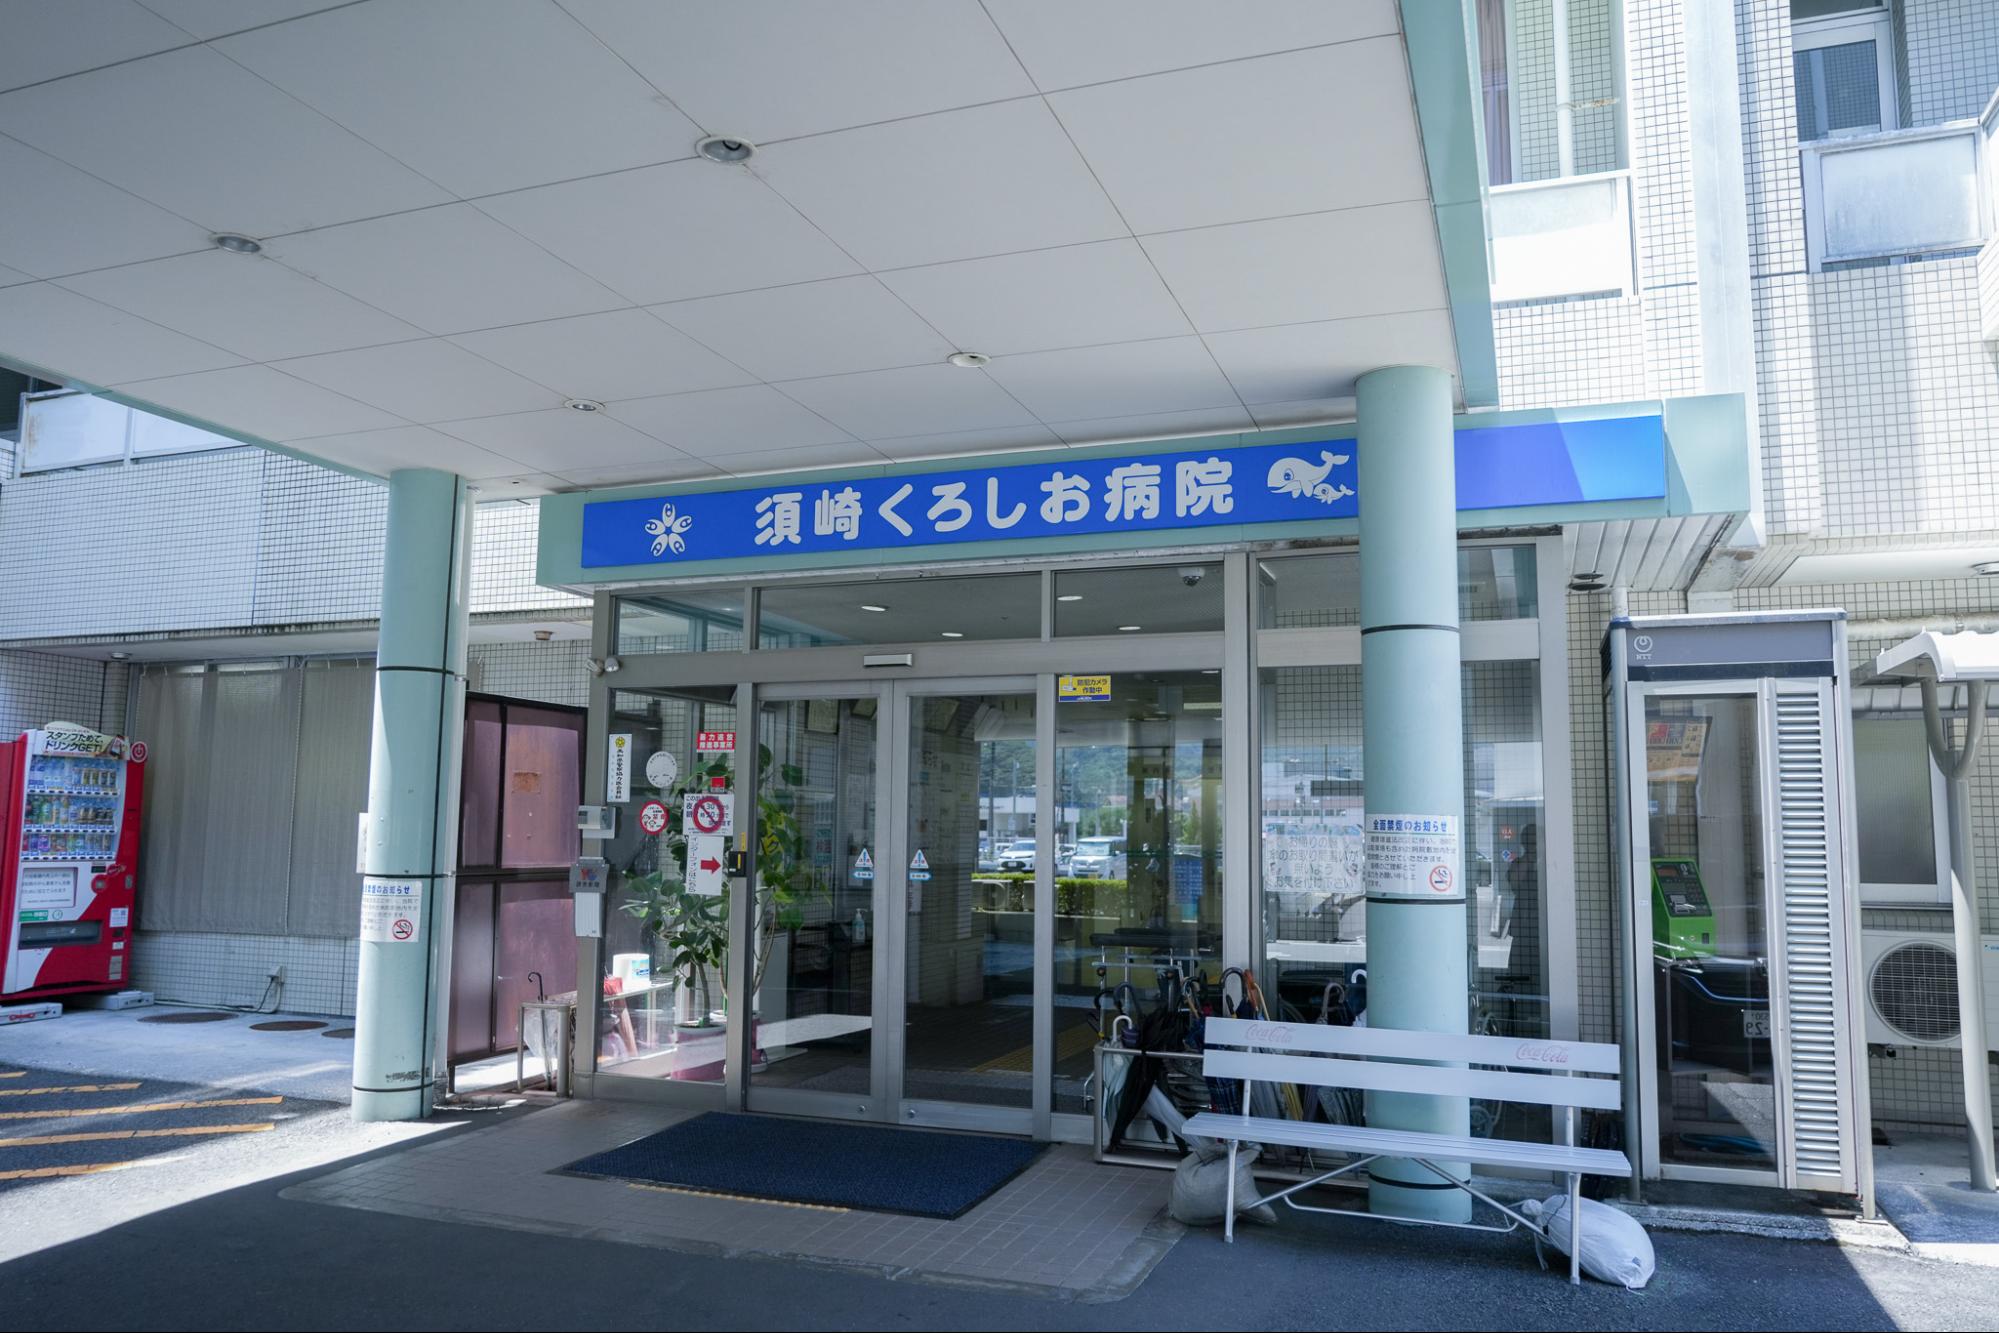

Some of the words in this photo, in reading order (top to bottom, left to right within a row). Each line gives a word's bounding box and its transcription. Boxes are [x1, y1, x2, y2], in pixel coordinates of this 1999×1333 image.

[753, 457, 1234, 547] 須崎くろしお病院
[1373, 819, 1447, 832] 全面禁煙のお知らせ
[1516, 1042, 1568, 1063] Coca-Cola
